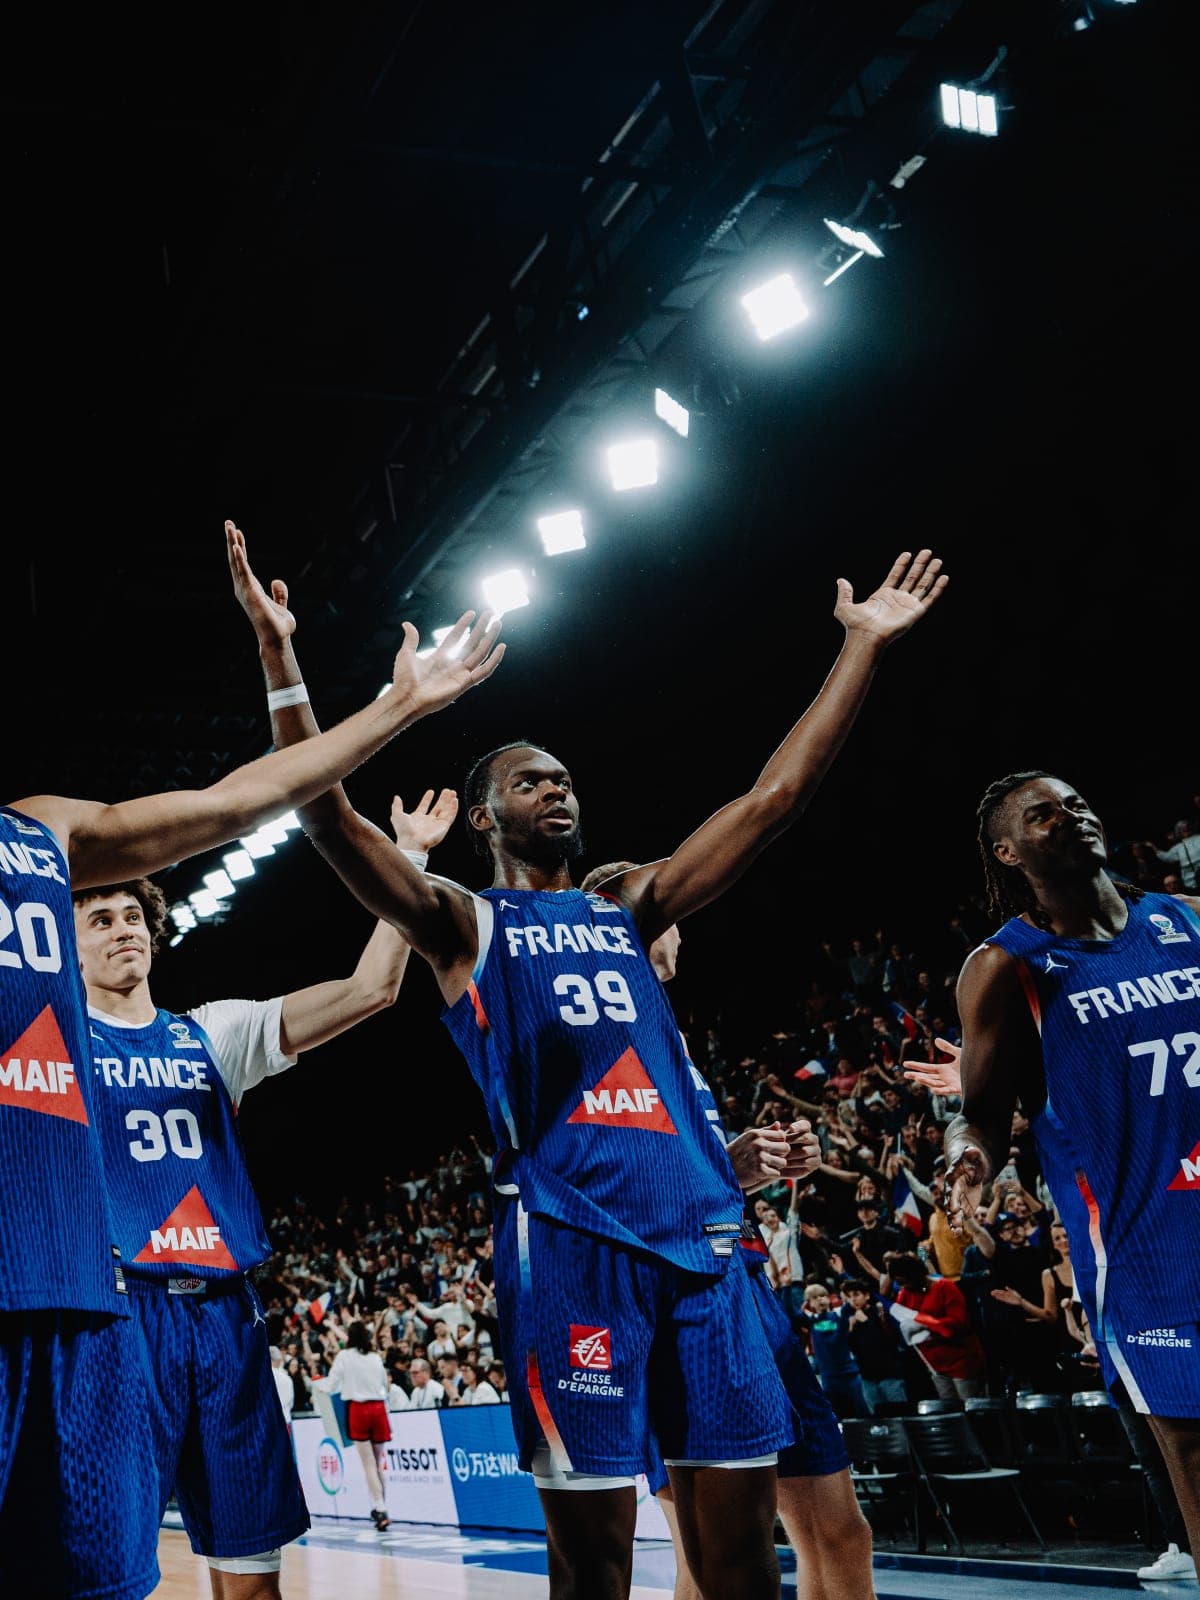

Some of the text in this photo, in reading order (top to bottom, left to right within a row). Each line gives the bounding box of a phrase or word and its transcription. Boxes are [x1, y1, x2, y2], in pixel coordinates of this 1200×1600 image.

[505, 923, 637, 957] FRANCE
[553, 970, 637, 1026] 39
[1128, 1031, 1200, 1097] 72
[583, 1088, 659, 1114] MAIF
[125, 1109, 203, 1162] 30
[150, 1226, 222, 1254] MAIF
[558, 1379, 624, 1397] D'EPARGNE
[572, 1371, 611, 1384] CAISSE
[387, 1448, 438, 1471] TISSOT
